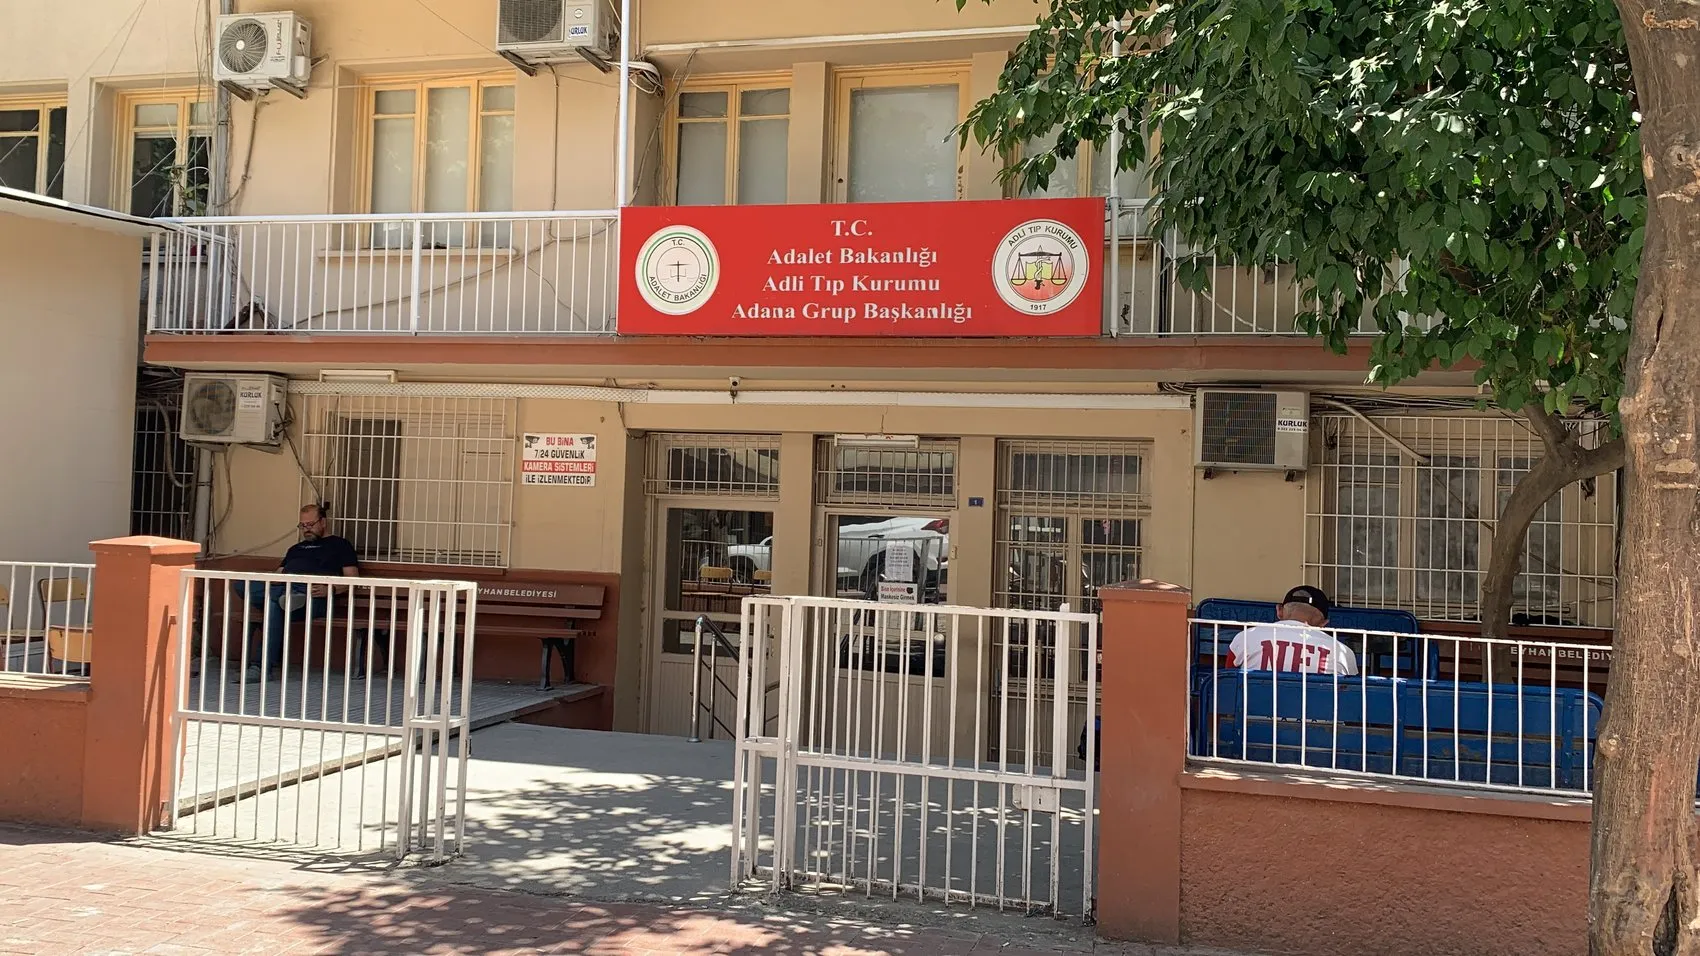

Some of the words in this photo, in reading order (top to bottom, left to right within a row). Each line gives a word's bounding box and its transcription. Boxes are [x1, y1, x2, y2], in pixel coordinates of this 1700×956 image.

[830, 219, 873, 237] T.C.
[1008, 229, 1026, 247] ADLİ
[1028, 226, 1041, 234] TIP
[1045, 226, 1078, 250] KURUMU
[766, 247, 833, 265] Adalet
[839, 246, 938, 268] Bakanlığı
[649, 276, 671, 300] ADALET
[761, 275, 805, 292] Adli
[810, 275, 845, 296] Tıp
[851, 274, 941, 292] Kurumu
[731, 302, 796, 319] Adana
[801, 302, 857, 324] Grup
[863, 302, 973, 324] Başkanlığı
[546, 437, 556, 446] BU
[524, 462, 553, 471] KAMERA
